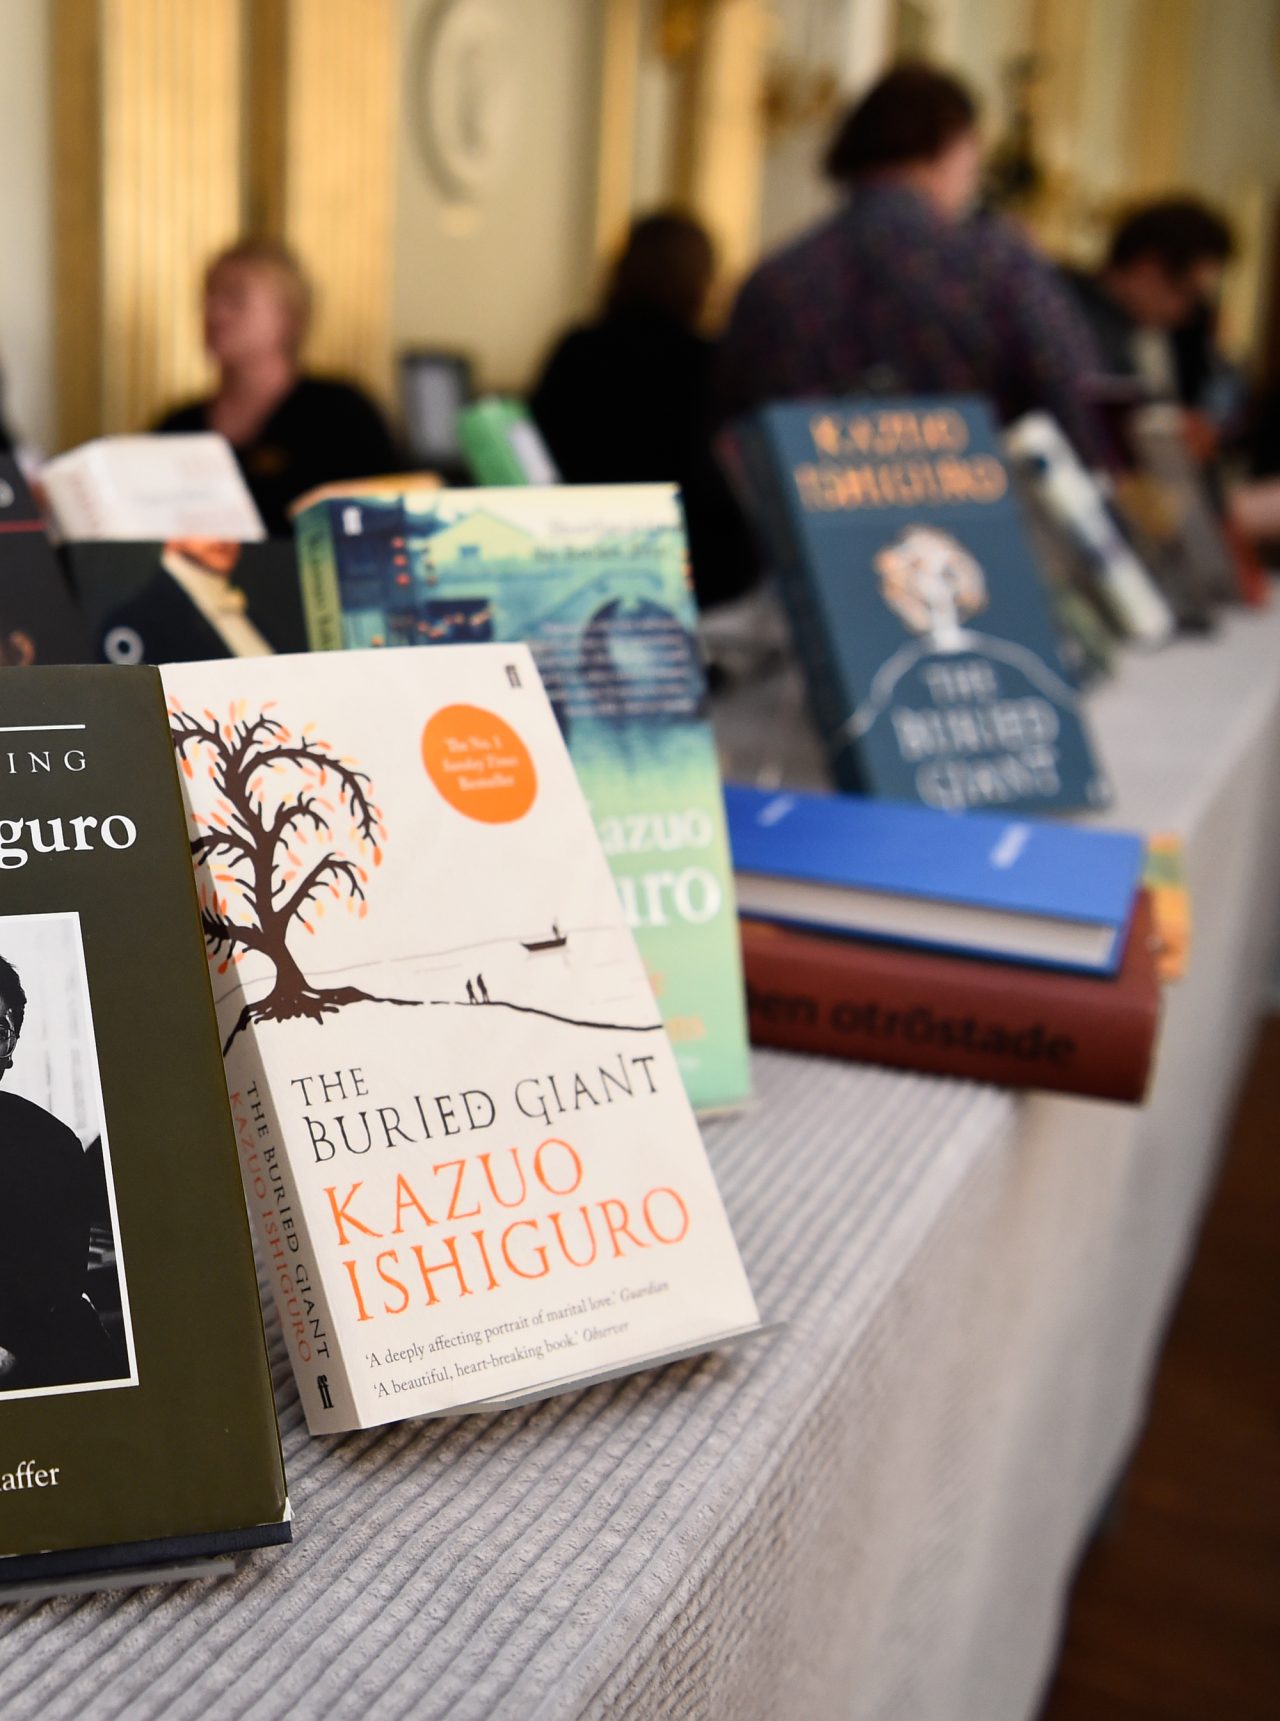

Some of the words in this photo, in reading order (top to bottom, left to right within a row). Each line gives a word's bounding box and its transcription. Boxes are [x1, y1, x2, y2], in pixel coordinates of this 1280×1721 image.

[442, 759, 485, 774] Sunday
[486, 754, 519, 768] Times
[445, 737, 468, 752] The
[458, 773, 515, 791] Bestseller
[595, 810, 714, 855] azuo
[290, 1066, 370, 1107] THE
[303, 1089, 497, 1163] BURIED
[514, 1053, 660, 1127] GIANT
[230, 1091, 268, 1200] KAZUO
[261, 1210, 312, 1363] ISHIGURO
[247, 1081, 270, 1139] THE
[263, 1145, 300, 1253] BURIED
[295, 1263, 330, 1359] GIANT
[323, 1138, 584, 1246] KAZUO
[342, 1186, 691, 1322] ISHIGURO
[384, 1343, 426, 1364] deeply
[429, 1330, 484, 1354] affecting
[483, 1315, 530, 1343] portrait
[531, 1311, 545, 1327] of
[546, 1300, 588, 1323] marital
[619, 1280, 670, 1303] Guardian
[392, 1364, 454, 1394] beautiful,
[455, 1345, 544, 1377] heart-breaking
[581, 1320, 631, 1344] Observer
